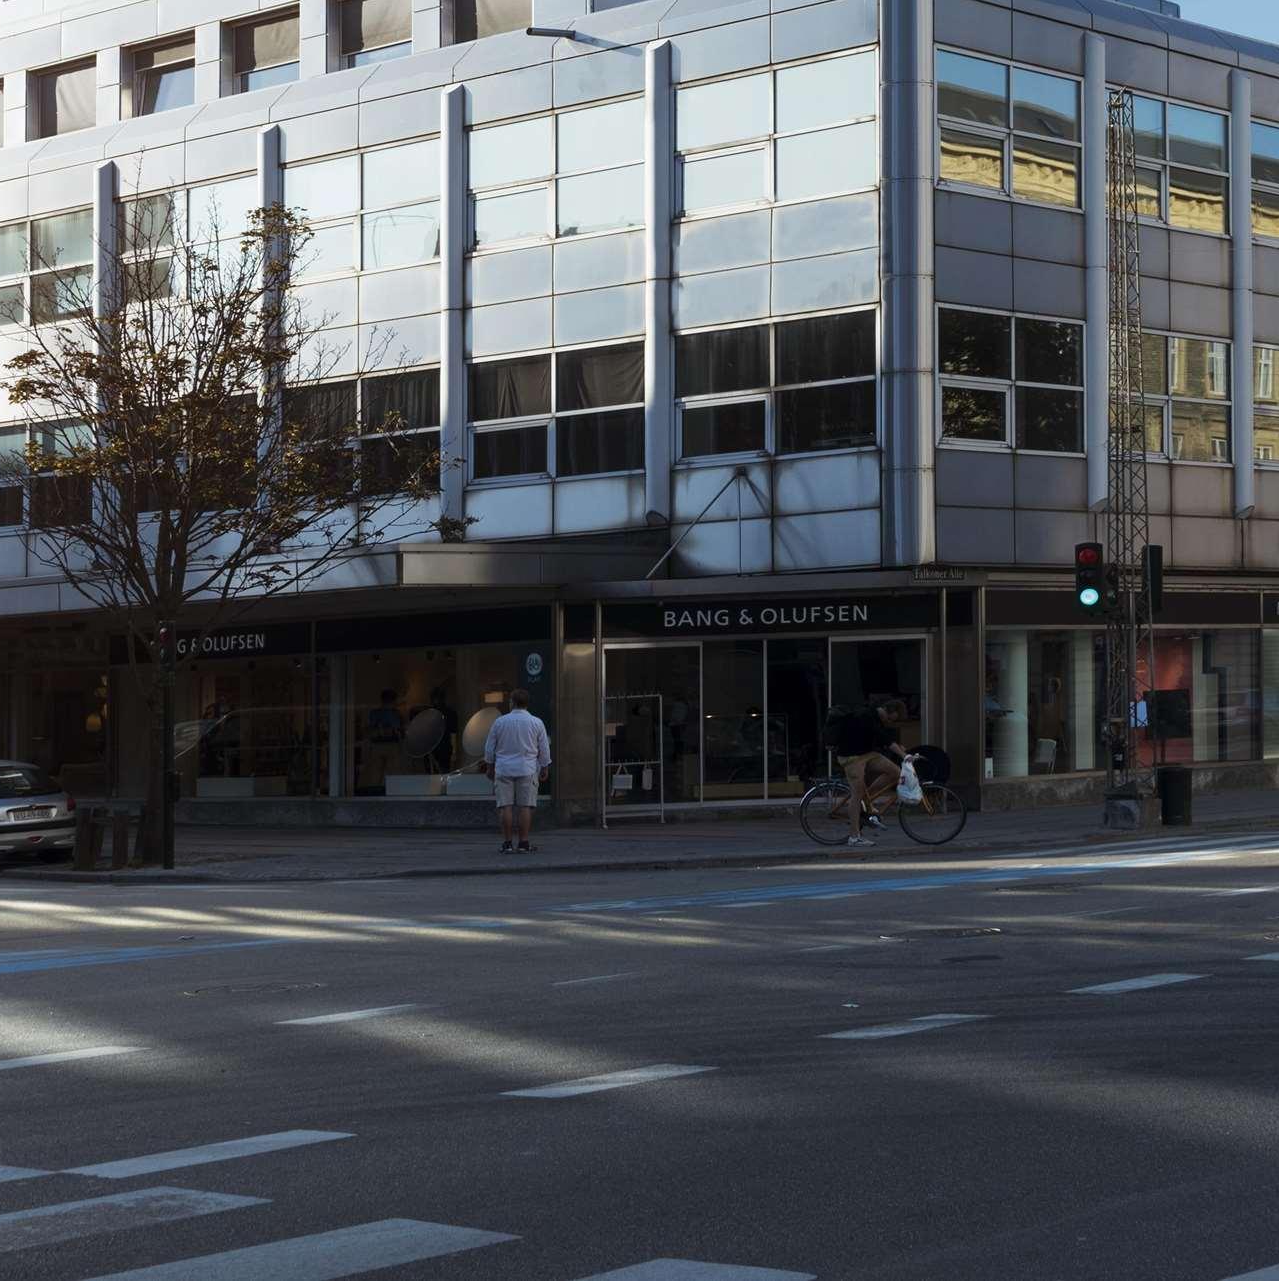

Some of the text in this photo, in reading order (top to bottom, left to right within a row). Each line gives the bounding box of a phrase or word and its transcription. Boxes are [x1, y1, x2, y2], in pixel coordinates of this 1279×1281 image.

[663, 605, 869, 628] BANG & OLUFSEN
[202, 633, 266, 653] OLUFSEN
